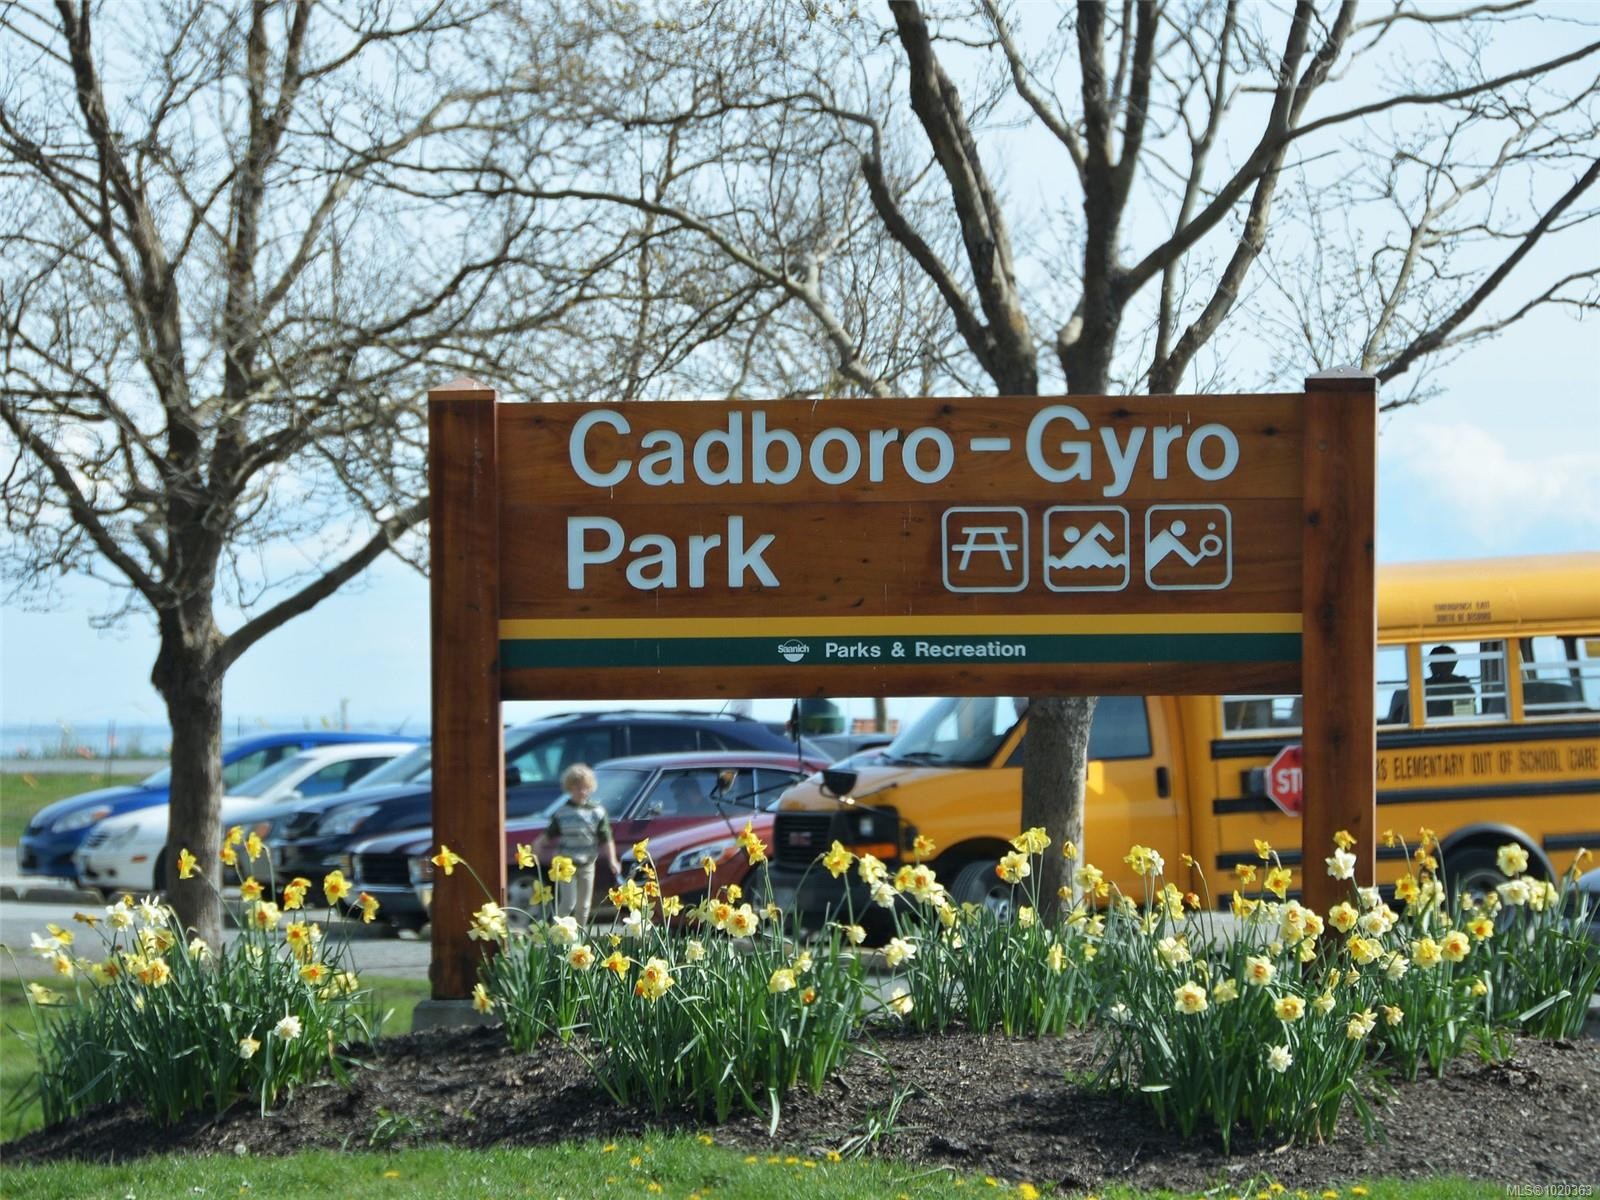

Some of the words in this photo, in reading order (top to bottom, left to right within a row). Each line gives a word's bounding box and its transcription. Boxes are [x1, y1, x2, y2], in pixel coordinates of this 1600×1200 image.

[566, 515, 781, 591] Park
[777, 642, 810, 654] Saanich
[824, 641, 881, 659] Parks
[890, 641, 906, 658] &
[914, 640, 1027, 658] Recreation
[1393, 752, 1464, 780] ELEMENTARY
[1471, 750, 1493, 776] OUT
[1498, 749, 1512, 775] OF
[1519, 747, 1563, 773] SCHOOL
[1569, 744, 1599, 770] CARE
[1276, 767, 1303, 794] ST
